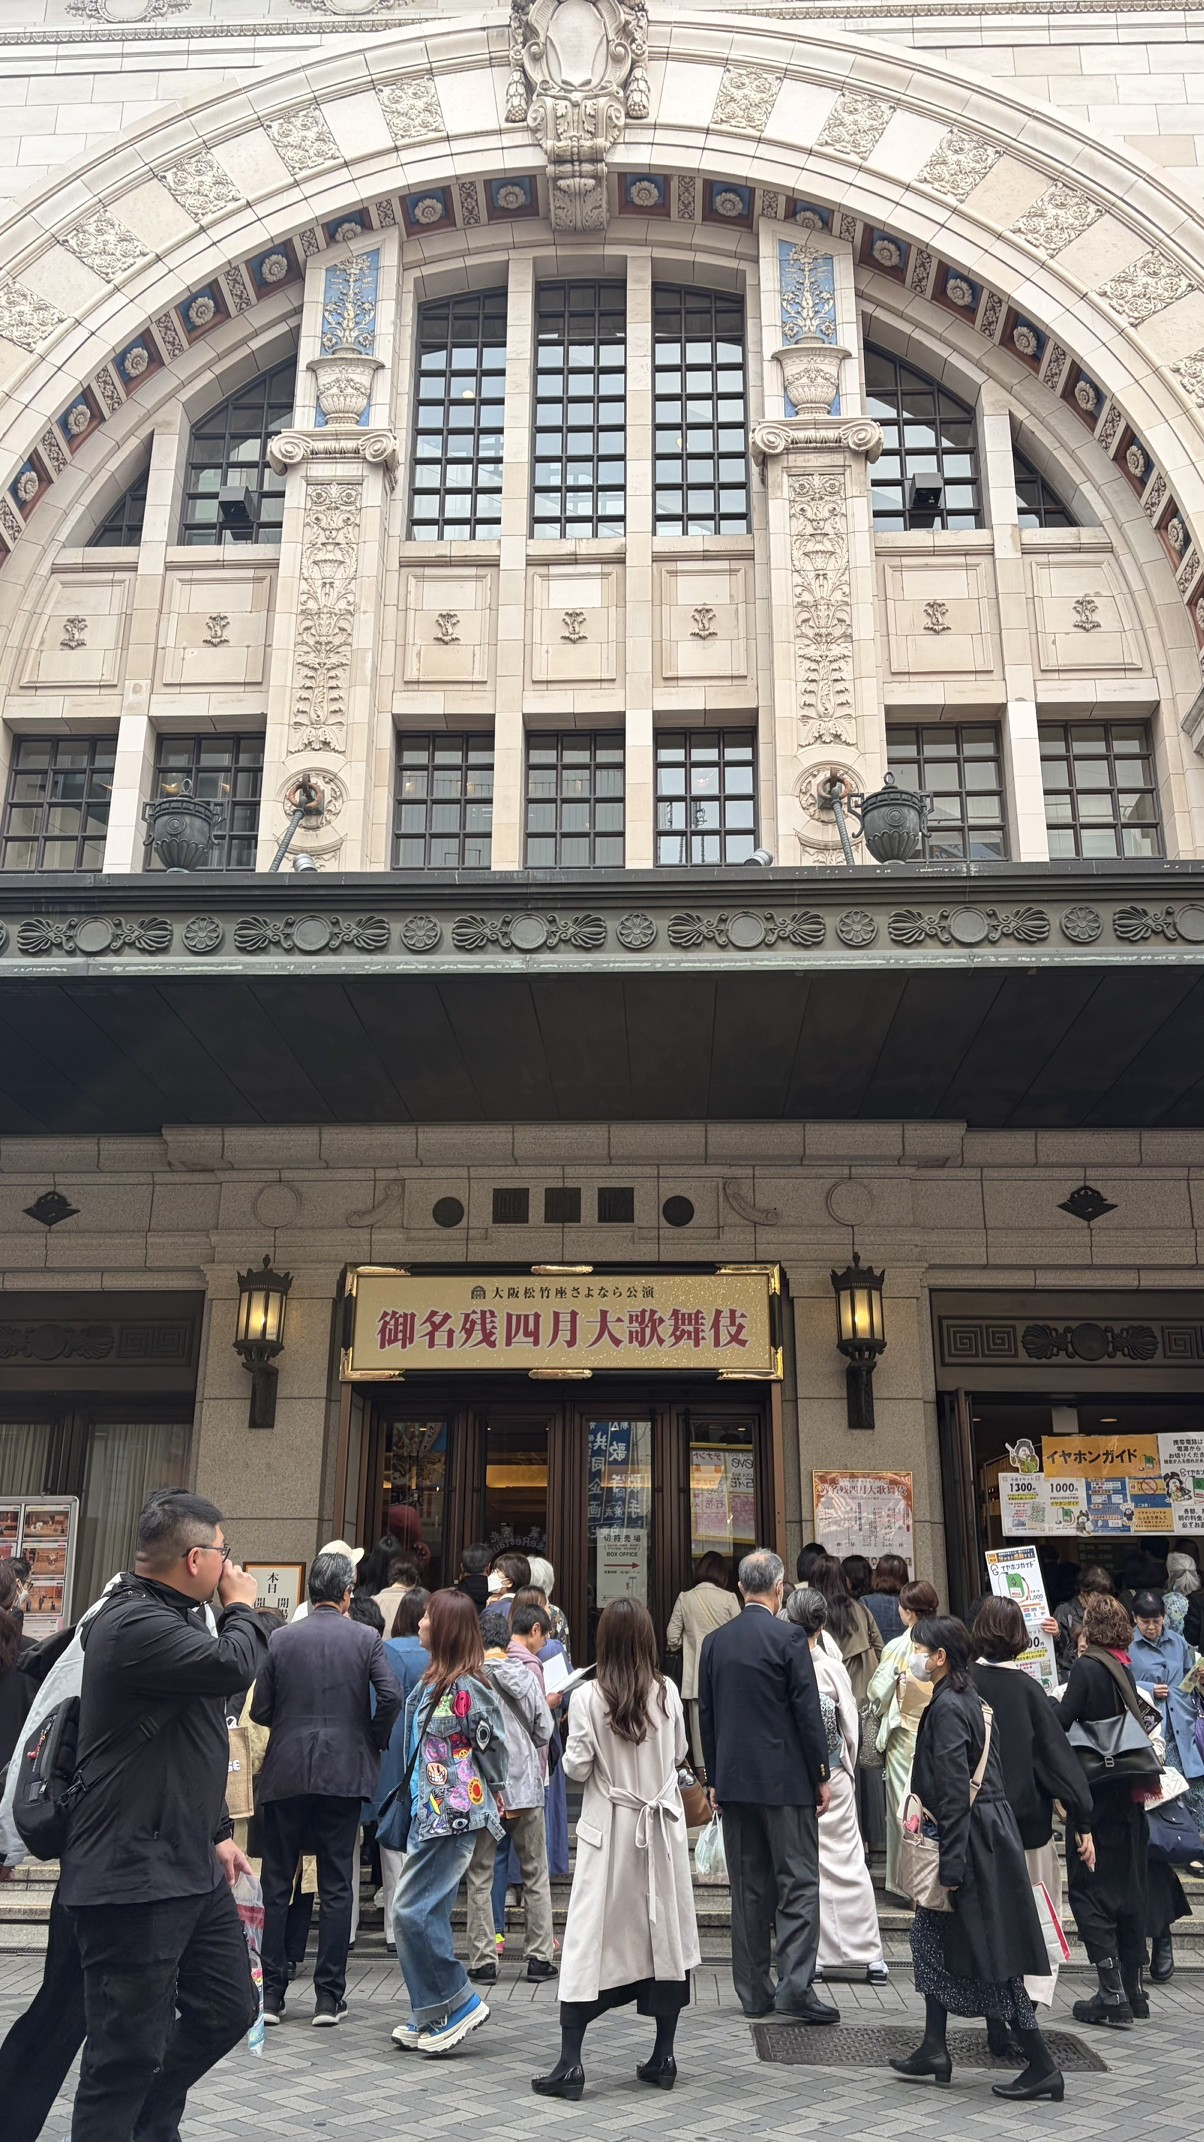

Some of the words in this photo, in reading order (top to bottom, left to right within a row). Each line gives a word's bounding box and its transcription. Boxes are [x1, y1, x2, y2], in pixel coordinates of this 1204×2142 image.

[491, 1285, 656, 1300] 大阪松竹座さよなら公演
[376, 1307, 750, 1351] 御名残四月大歌舞伎
[1046, 1448, 1138, 1465] イヤホンガイド
[267, 1572, 279, 1594] 本日
